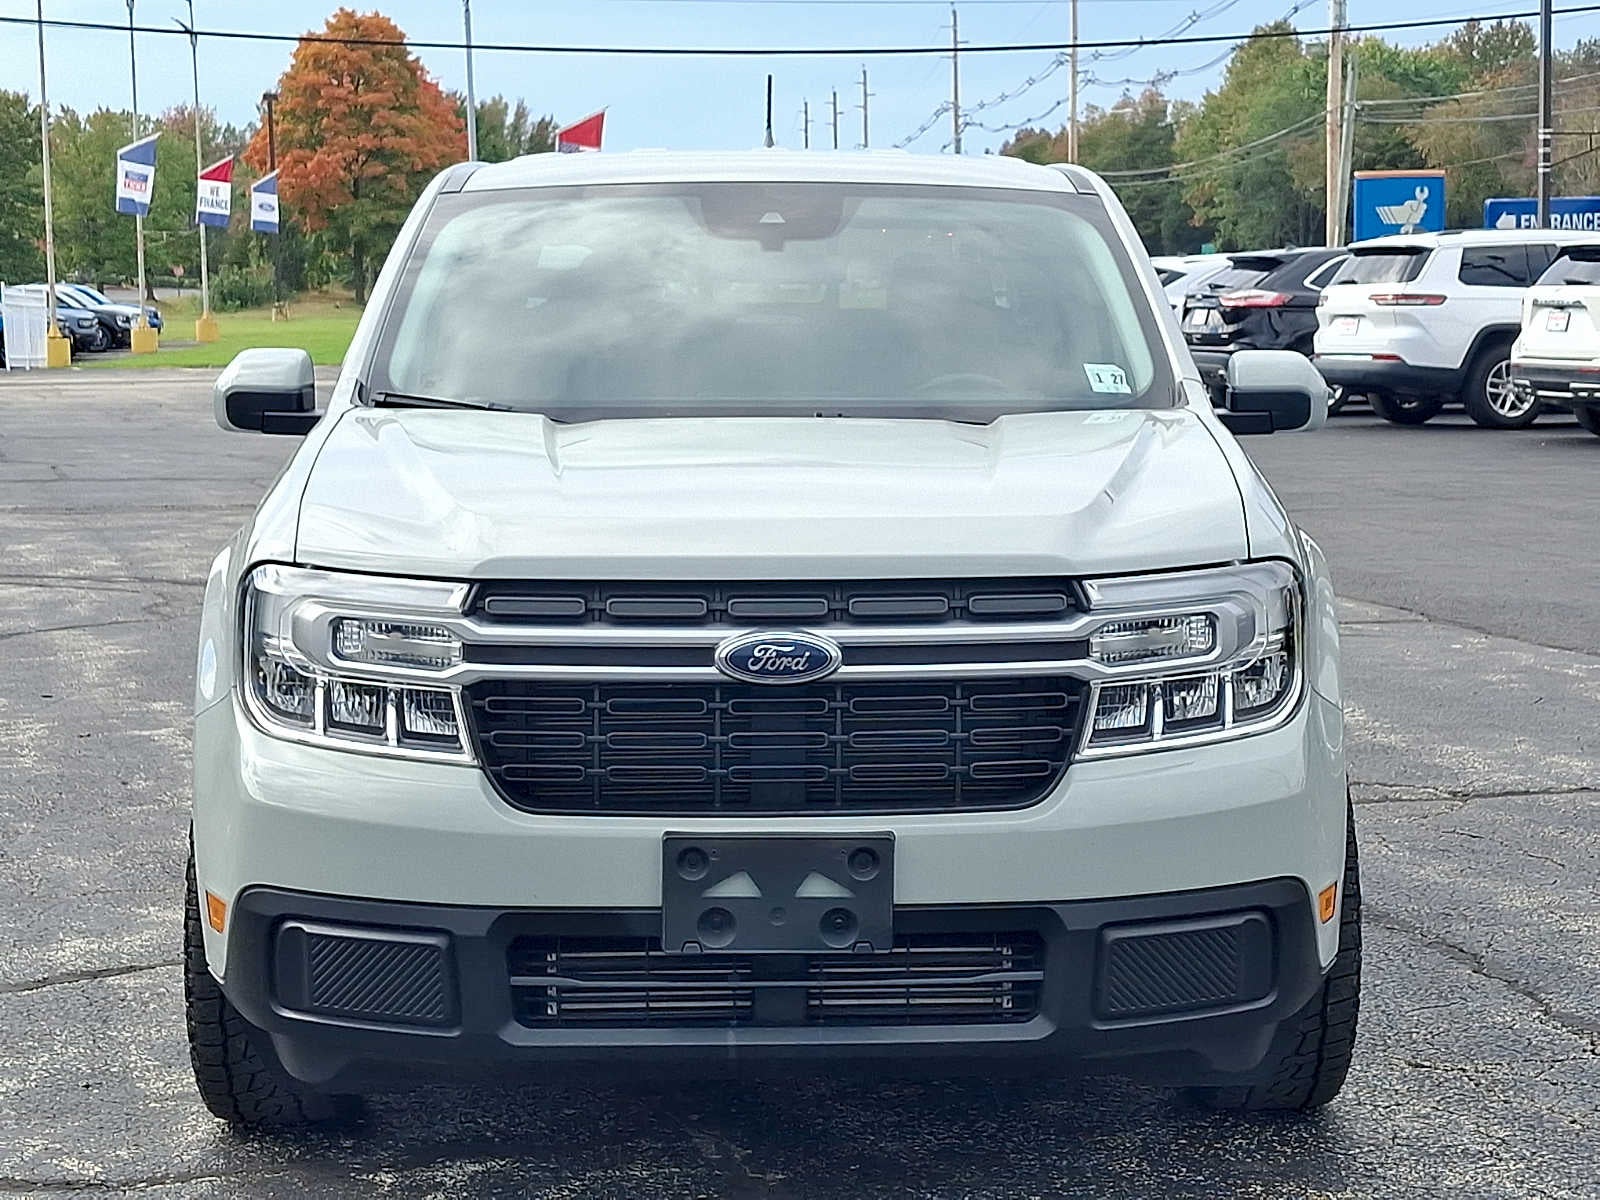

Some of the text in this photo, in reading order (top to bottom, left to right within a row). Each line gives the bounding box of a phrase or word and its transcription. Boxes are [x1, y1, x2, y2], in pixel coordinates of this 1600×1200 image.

[210, 187, 220, 197] WE
[200, 196, 228, 210] FINANCE
[1522, 212, 1600, 230] ENRANCE
[748, 644, 812, 671] Ford
